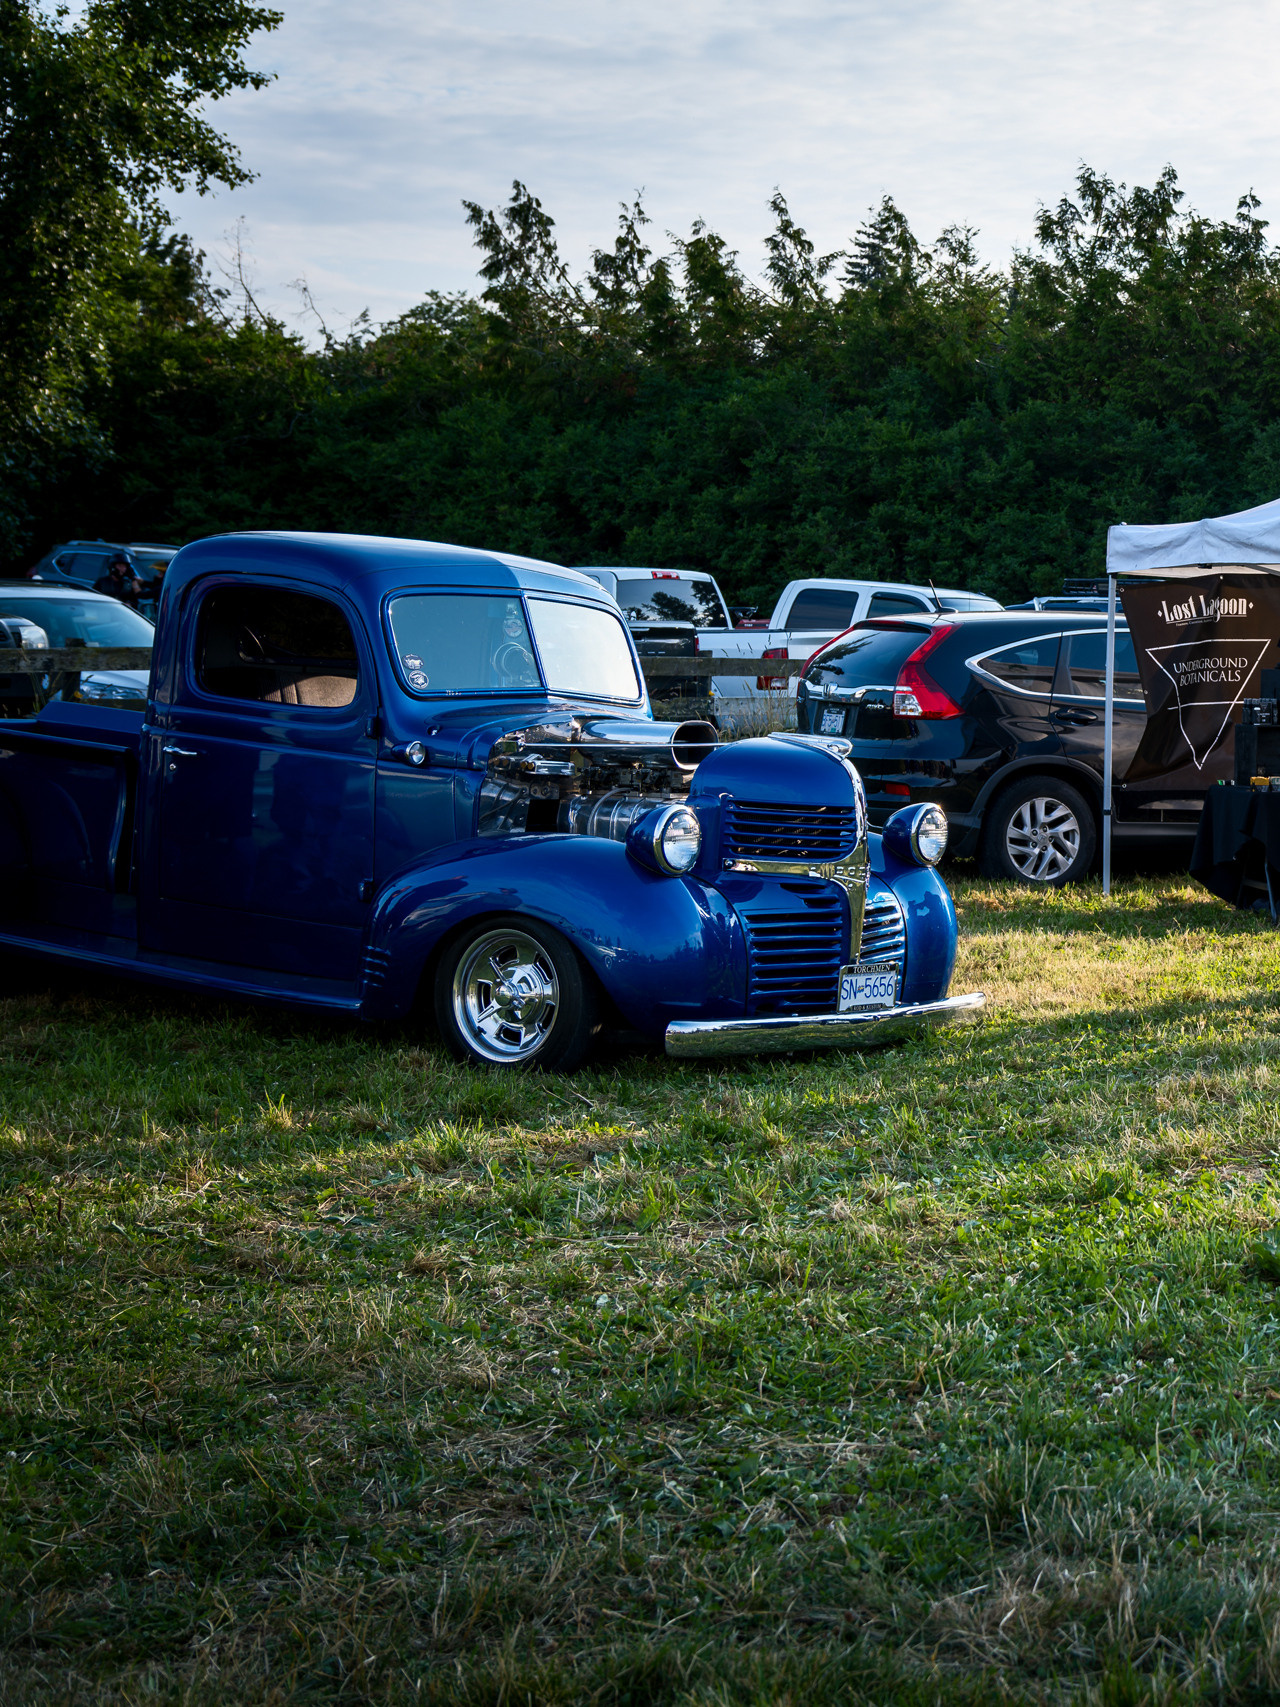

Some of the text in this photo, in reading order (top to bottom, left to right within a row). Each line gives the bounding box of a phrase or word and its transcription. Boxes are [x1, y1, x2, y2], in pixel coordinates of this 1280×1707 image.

[1162, 595, 1247, 622] Lost Lagoon
[1173, 657, 1248, 674] UNDERGROUND
[1180, 669, 1241, 687] BOTANICALS
[853, 964, 891, 974] TORCHMEN
